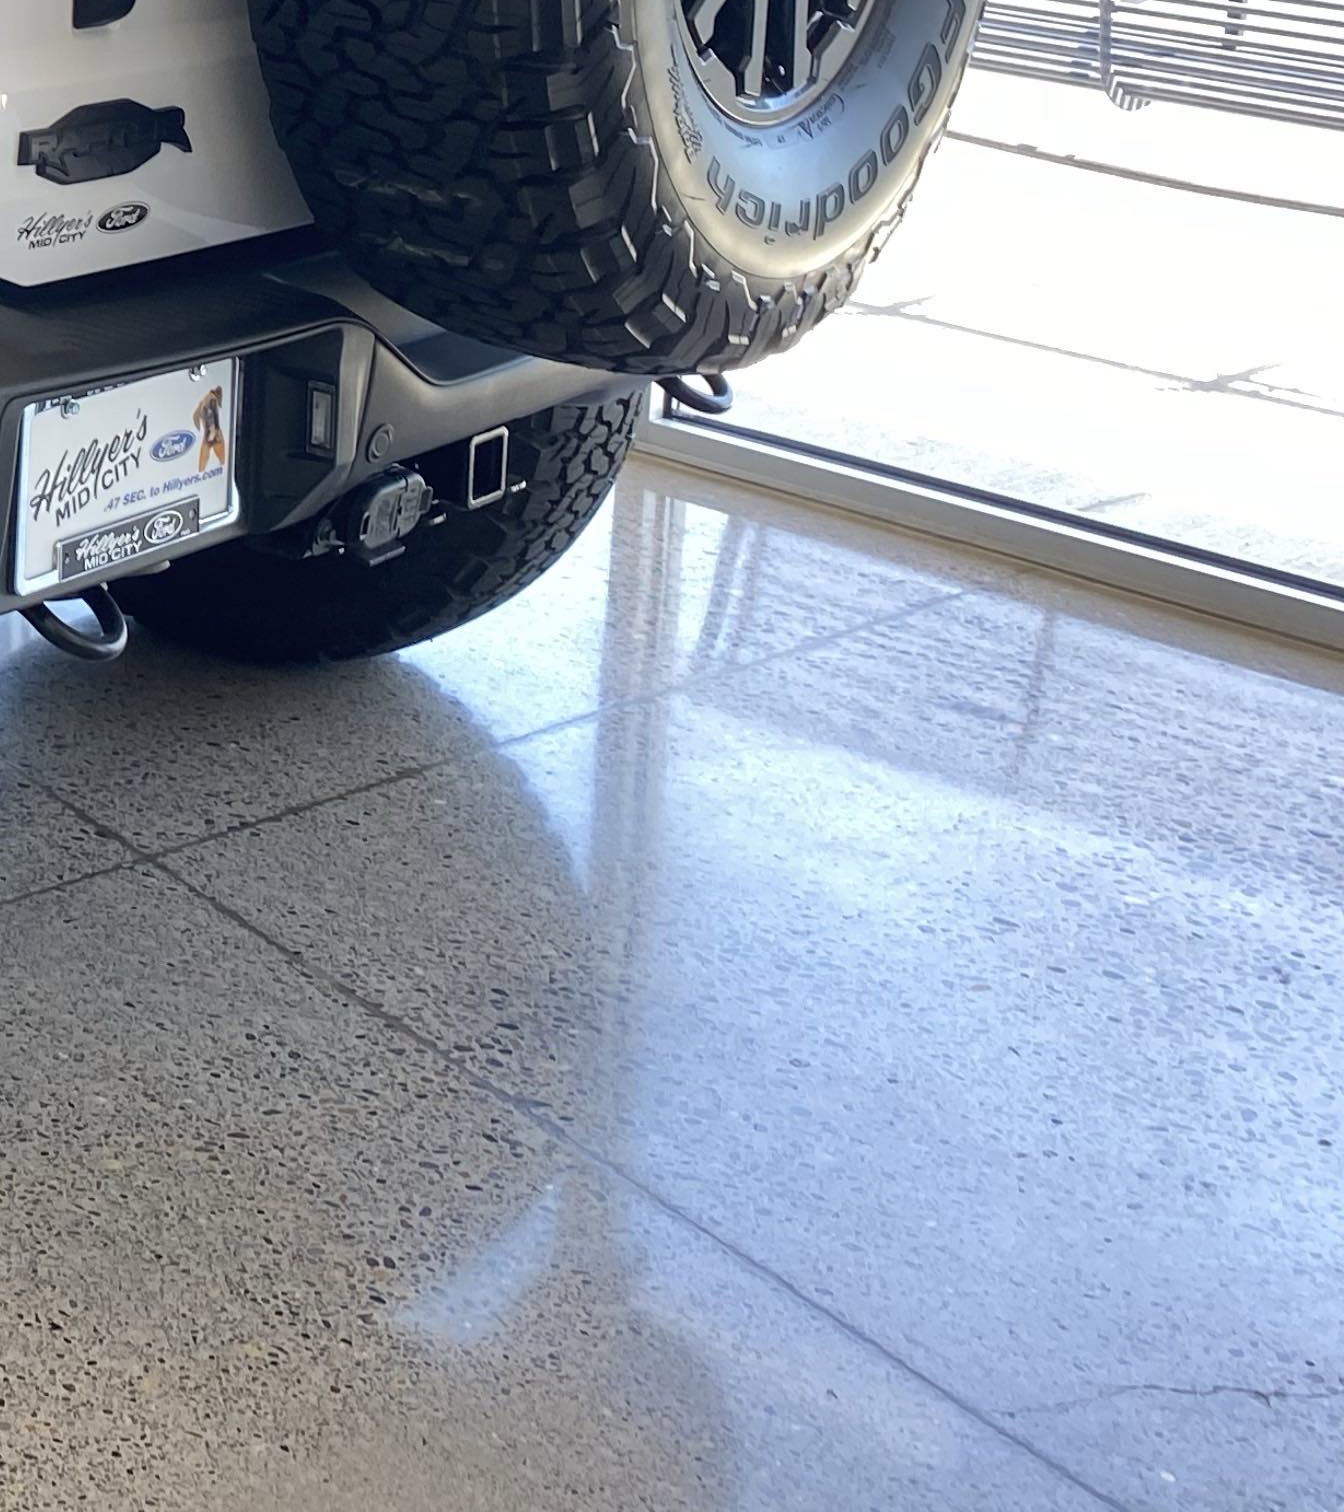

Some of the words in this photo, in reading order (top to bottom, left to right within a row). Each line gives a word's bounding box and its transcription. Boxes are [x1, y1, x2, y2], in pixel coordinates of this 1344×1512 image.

[28, 236, 53, 250] MID
[58, 230, 87, 244] CITY
[29, 408, 148, 522] Hillyer's
[55, 487, 91, 528] MID
[101, 446, 144, 490] CITY
[150, 485, 160, 498] to
[84, 554, 109, 571] MID
[111, 539, 143, 561] CITY
